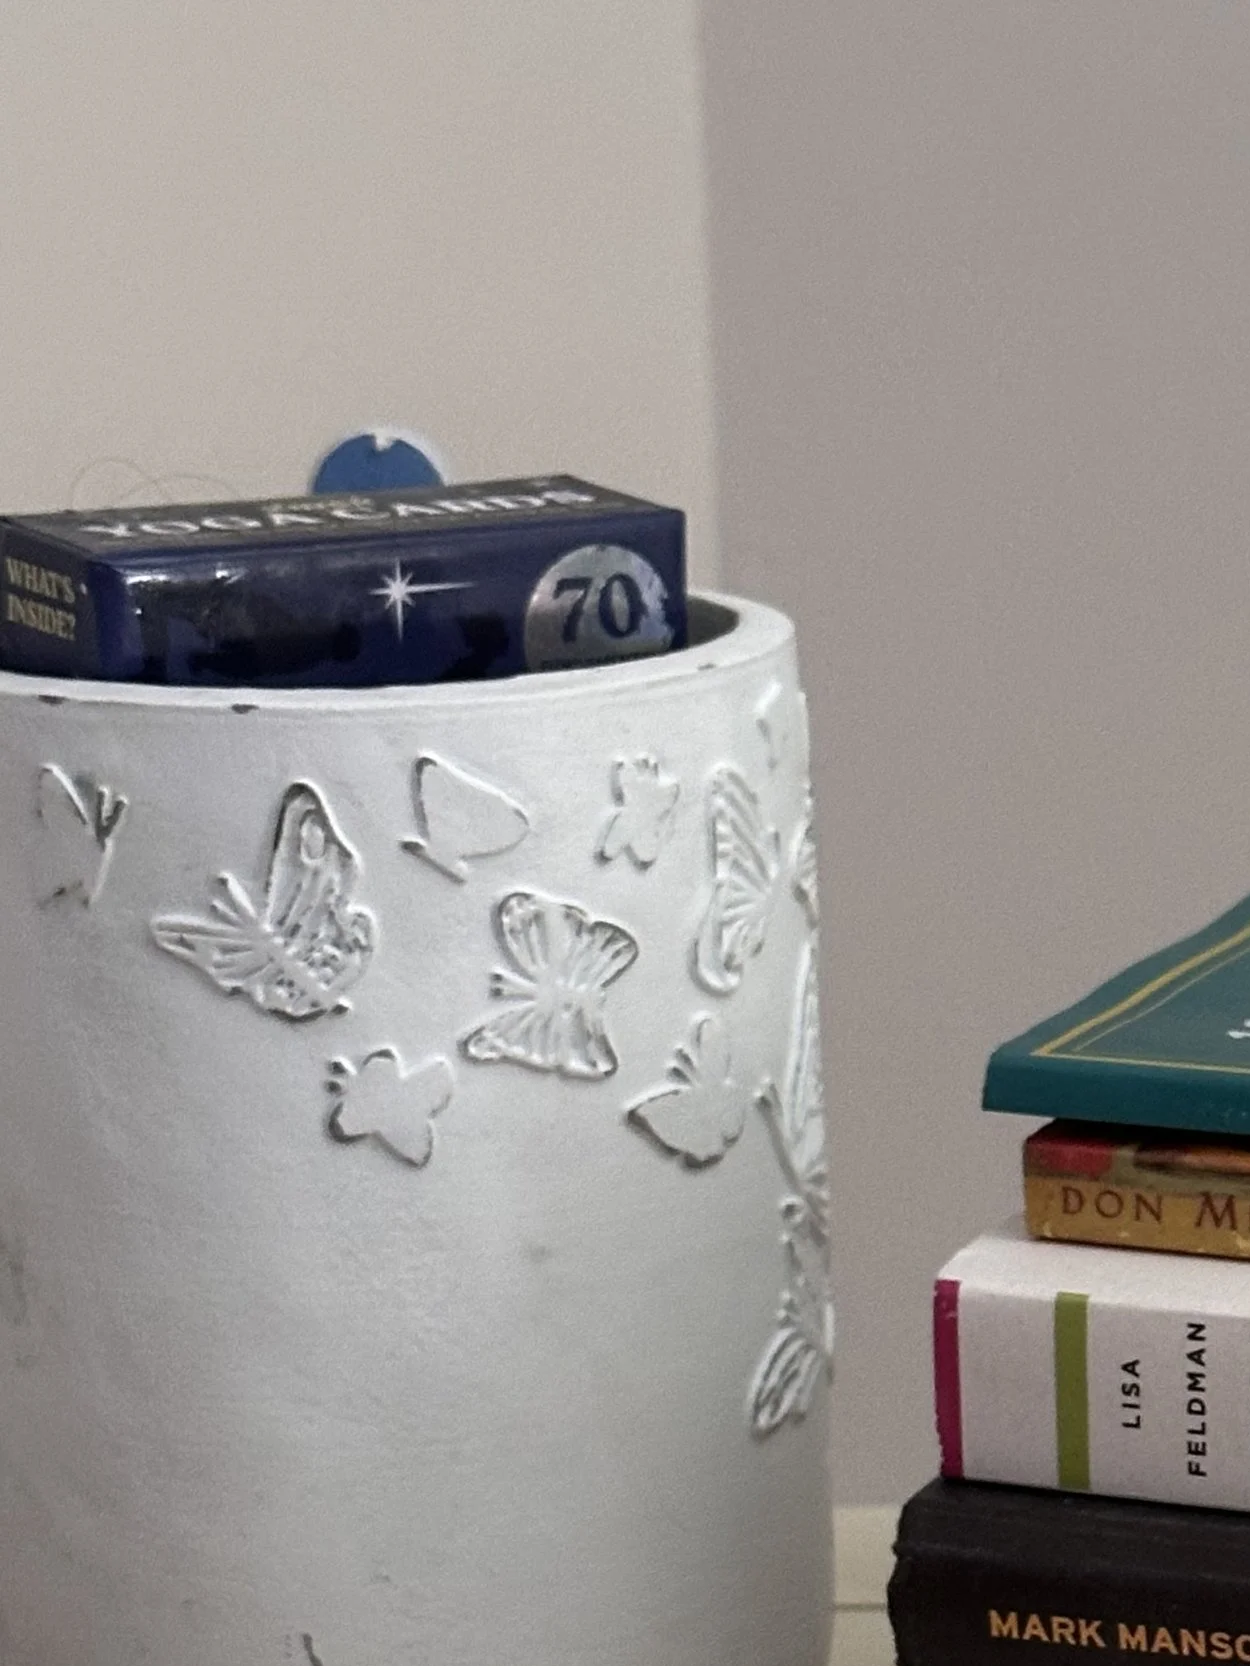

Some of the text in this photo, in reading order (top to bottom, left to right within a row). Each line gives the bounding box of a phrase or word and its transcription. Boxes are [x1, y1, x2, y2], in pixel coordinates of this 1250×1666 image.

[553, 574, 645, 643] 70
[1060, 1186, 1164, 1224] DON
[1120, 1358, 1141, 1430] LISA
[1188, 1321, 1208, 1477] FELDMAN
[988, 1608, 1106, 1648] MARK
